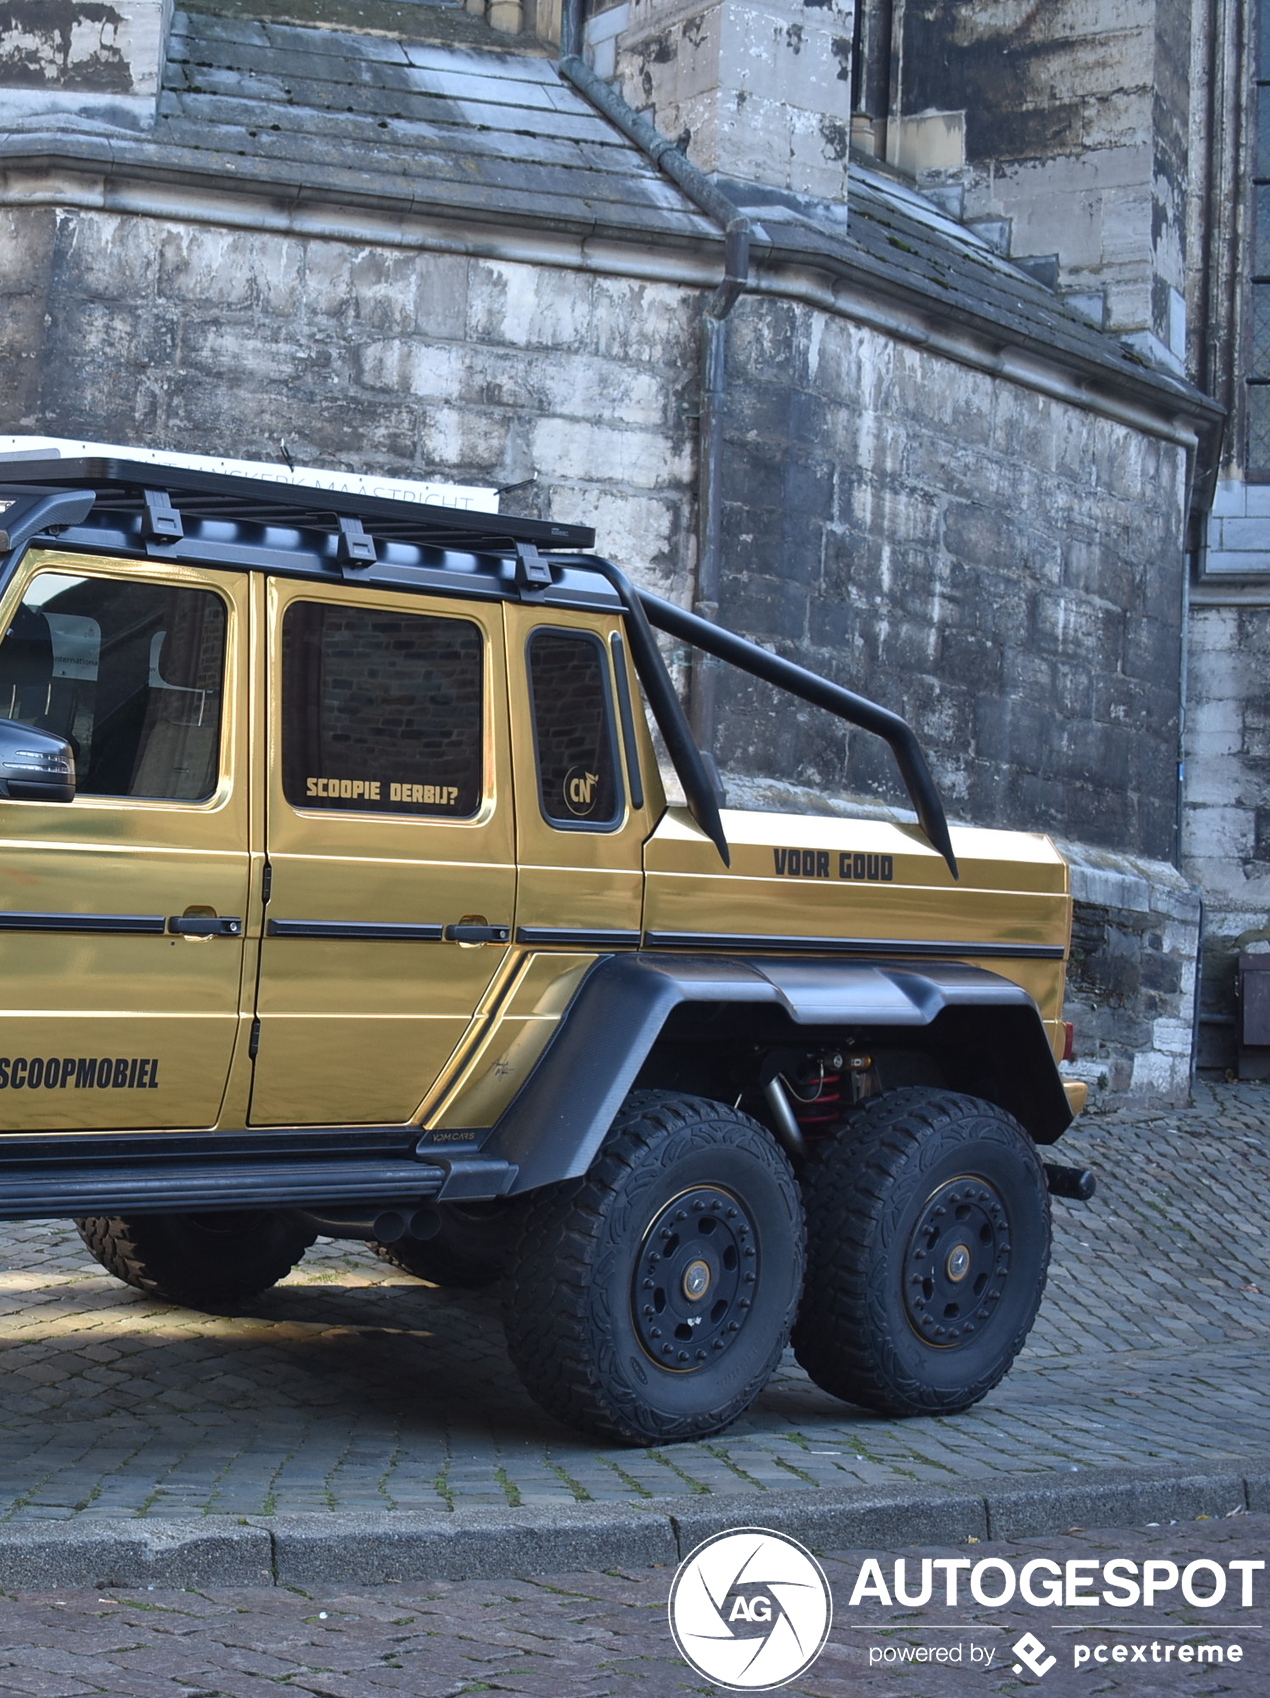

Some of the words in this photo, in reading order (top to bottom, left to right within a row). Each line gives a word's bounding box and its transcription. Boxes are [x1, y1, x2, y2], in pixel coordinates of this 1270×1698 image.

[306, 777, 380, 800] SCOOPIE
[390, 783, 459, 805] DERBIJ?
[569, 778, 592, 804] CN
[773, 848, 830, 878] VOOR
[839, 852, 893, 881] GOUD
